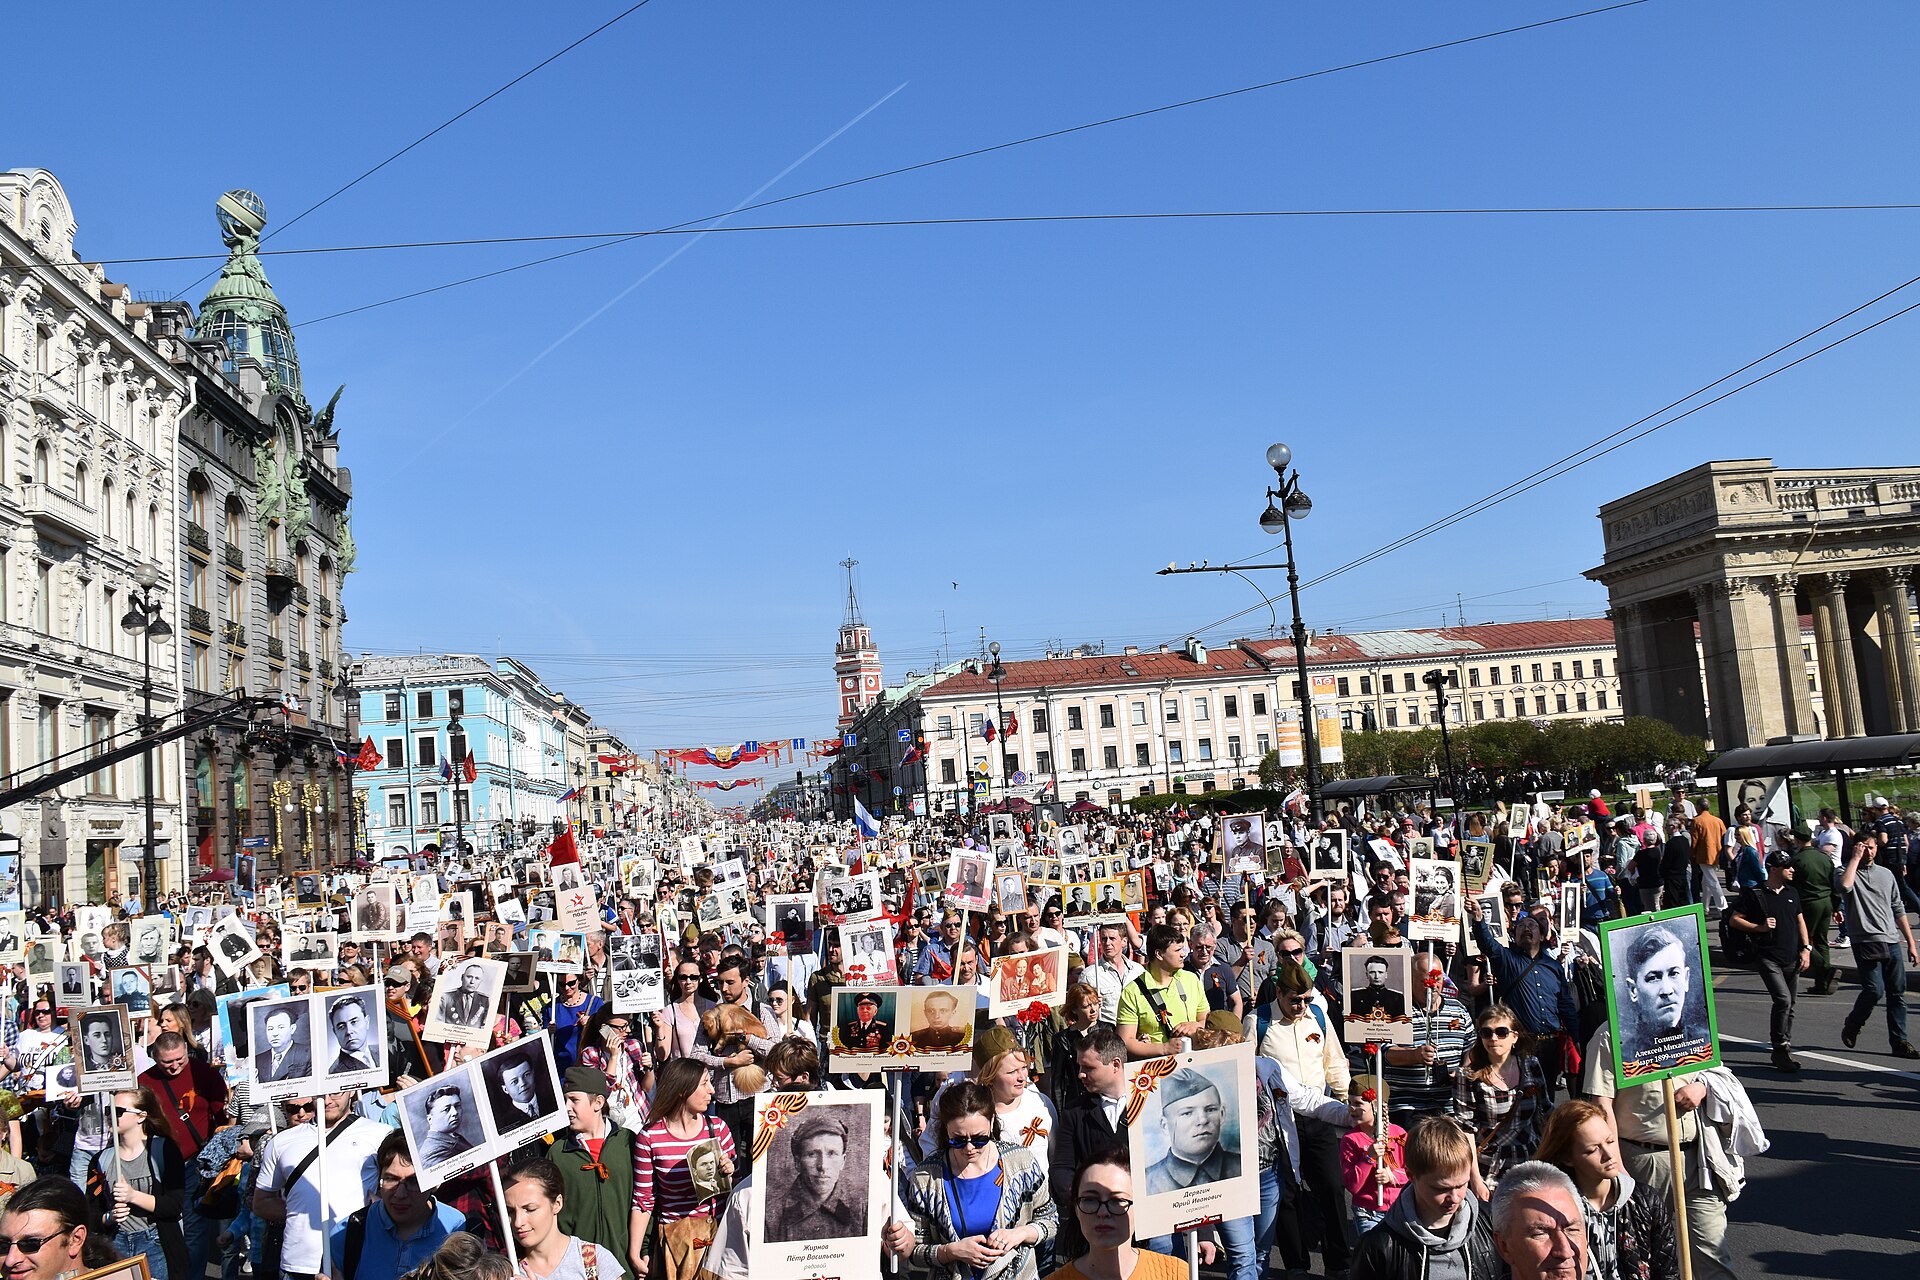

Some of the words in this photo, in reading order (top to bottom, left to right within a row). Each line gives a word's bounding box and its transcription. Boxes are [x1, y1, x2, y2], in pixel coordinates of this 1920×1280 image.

[1654, 1034, 1684, 1045] Голицын
[1635, 1047, 1662, 1058] Алексей
[1663, 1038, 1705, 1052] Михайлович
[1690, 1046, 1705, 1055] 1942
[1183, 1188, 1210, 1199] Дерягин
[1172, 1199, 1191, 1209] Юрий
[1191, 1193, 1223, 1205] Иванович
[1185, 1204, 1210, 1214] сержант
[786, 1254, 806, 1262] Пётр
[806, 1252, 845, 1261] Васильевич
[803, 1262, 827, 1270] рядовой
